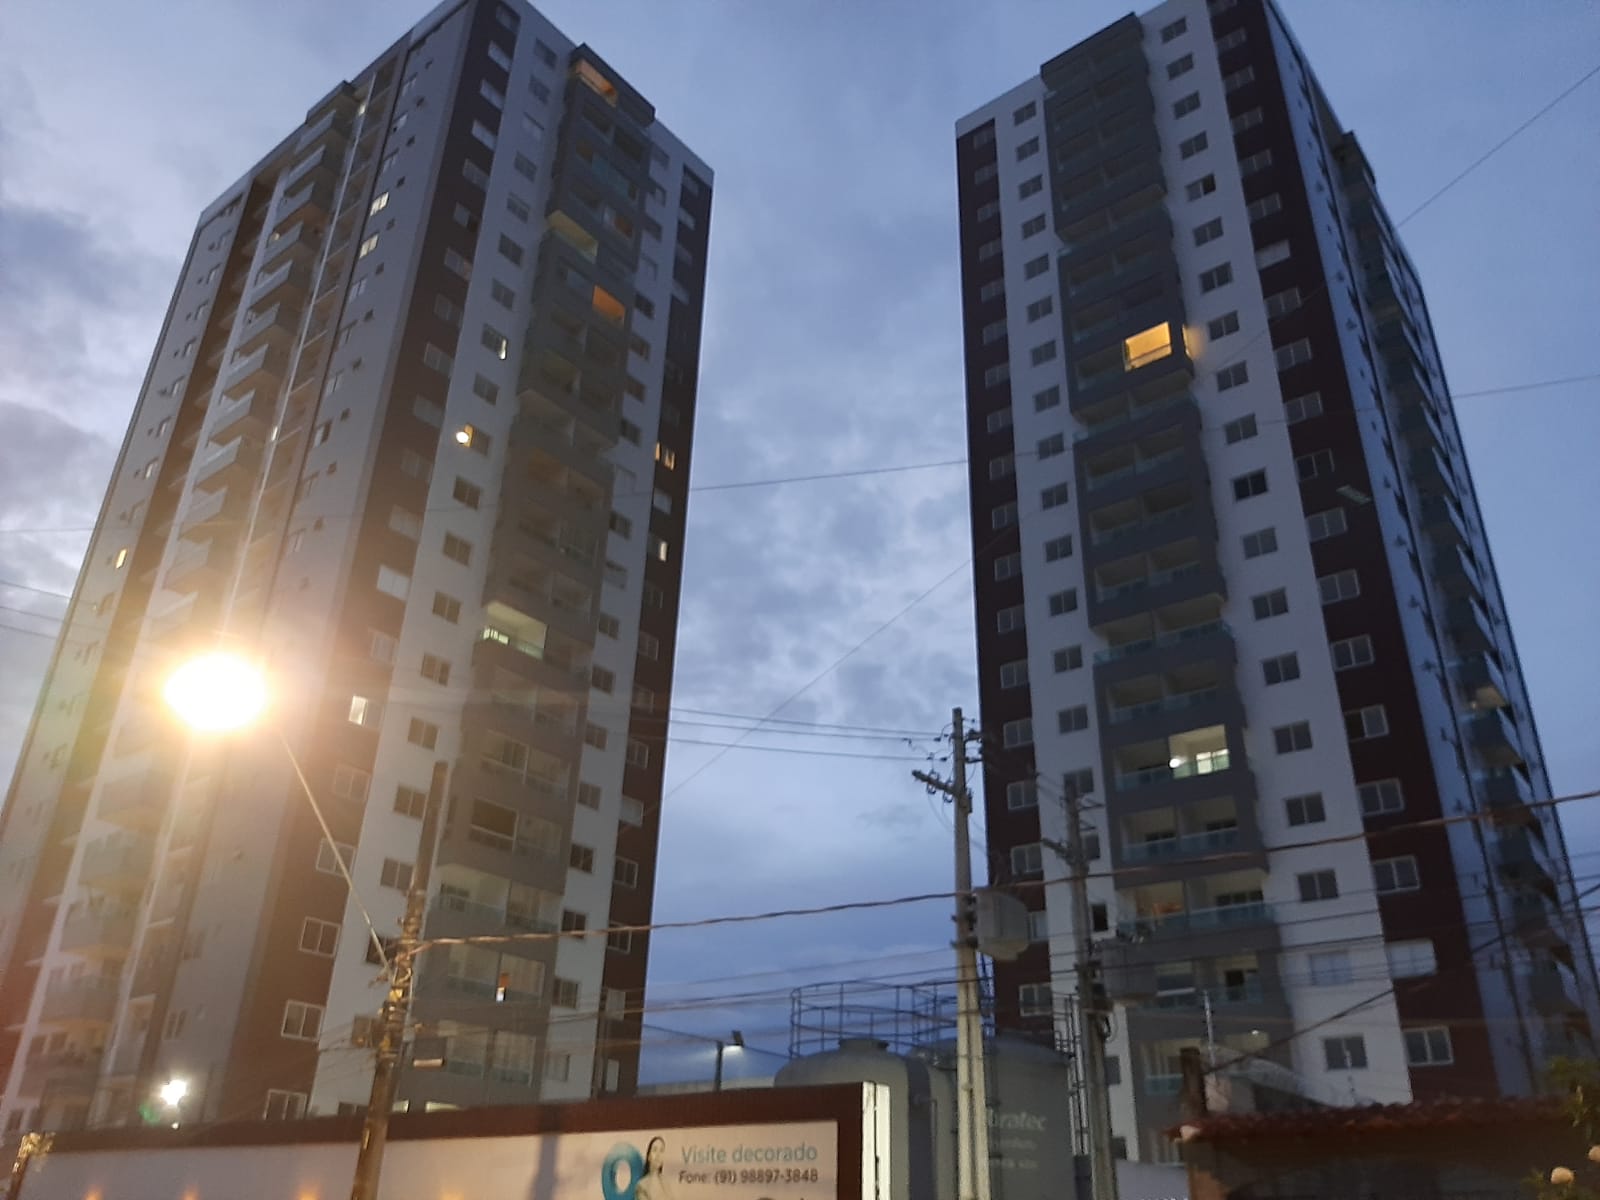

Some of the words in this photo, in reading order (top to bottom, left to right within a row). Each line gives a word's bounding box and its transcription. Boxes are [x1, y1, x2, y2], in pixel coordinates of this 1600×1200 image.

[681, 1144, 727, 1164] Visite
[732, 1141, 817, 1163] decorado
[714, 1169, 737, 1184] (91)
[740, 1168, 819, 1184] 98897-3848
